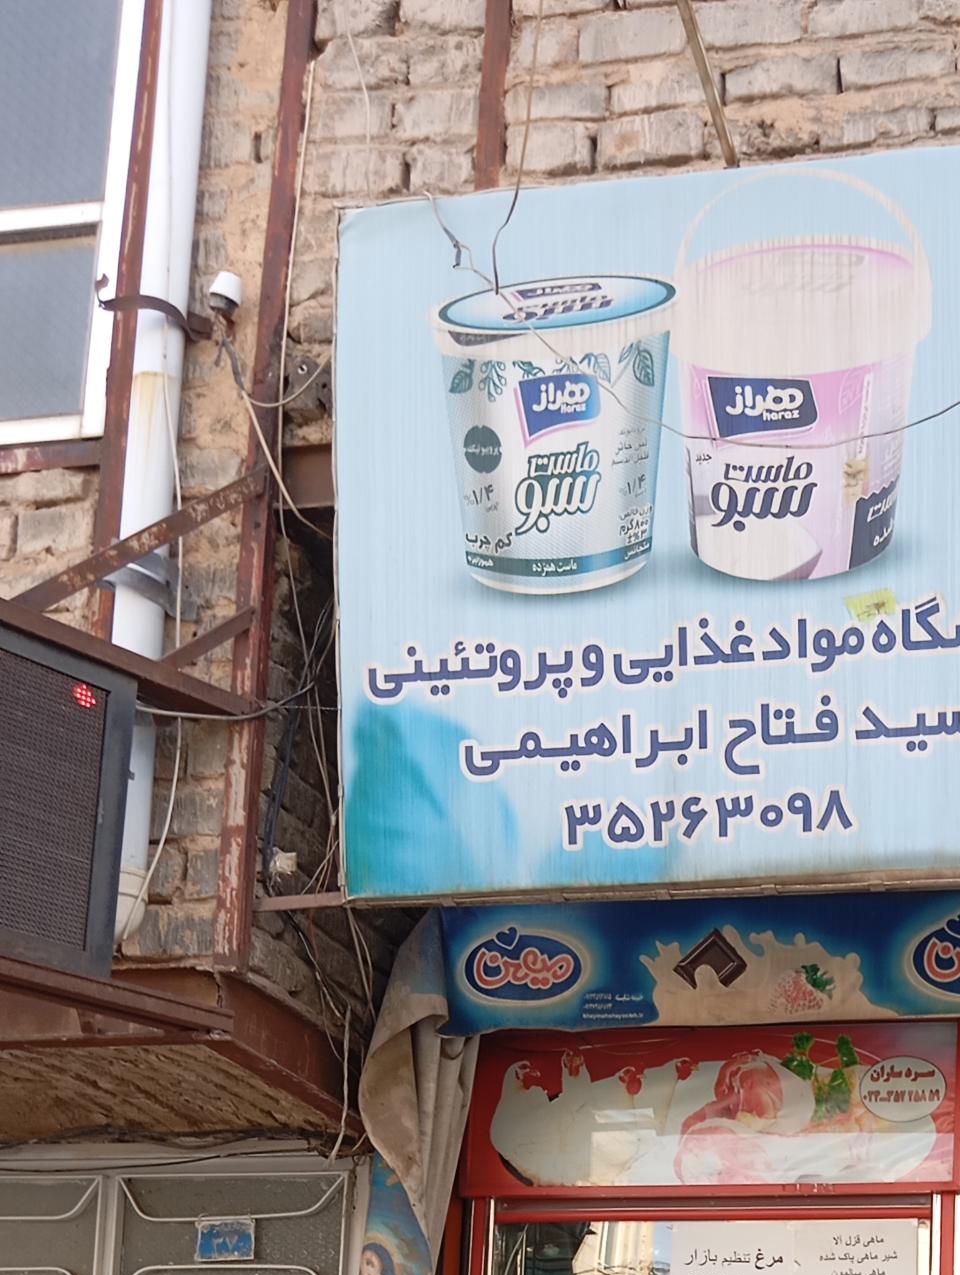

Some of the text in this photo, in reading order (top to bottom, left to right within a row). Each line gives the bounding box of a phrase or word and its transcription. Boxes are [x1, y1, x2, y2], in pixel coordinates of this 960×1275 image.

[532, 380, 591, 412] هراز
[725, 385, 804, 416] هراز
[762, 408, 800, 421] haraz
[515, 472, 601, 535] سبو
[711, 482, 817, 532] سبو
[613, 617, 755, 684] غذایی
[762, 618, 865, 673] مواد
[368, 641, 574, 699] پروتئینی
[465, 709, 708, 776] ابراهیمی
[724, 695, 839, 775] فتاح
[565, 789, 853, 845] ۳۵۲۶۳۰۹۸
[473, 946, 574, 990] میهن
[684, 1248, 784, 1270] مرغ تنظیم بازار
[819, 1252, 898, 1264] شیر ماهی پاک شده
[845, 1235, 861, 1246] قزل
[862, 1235, 885, 1247] ماهی
